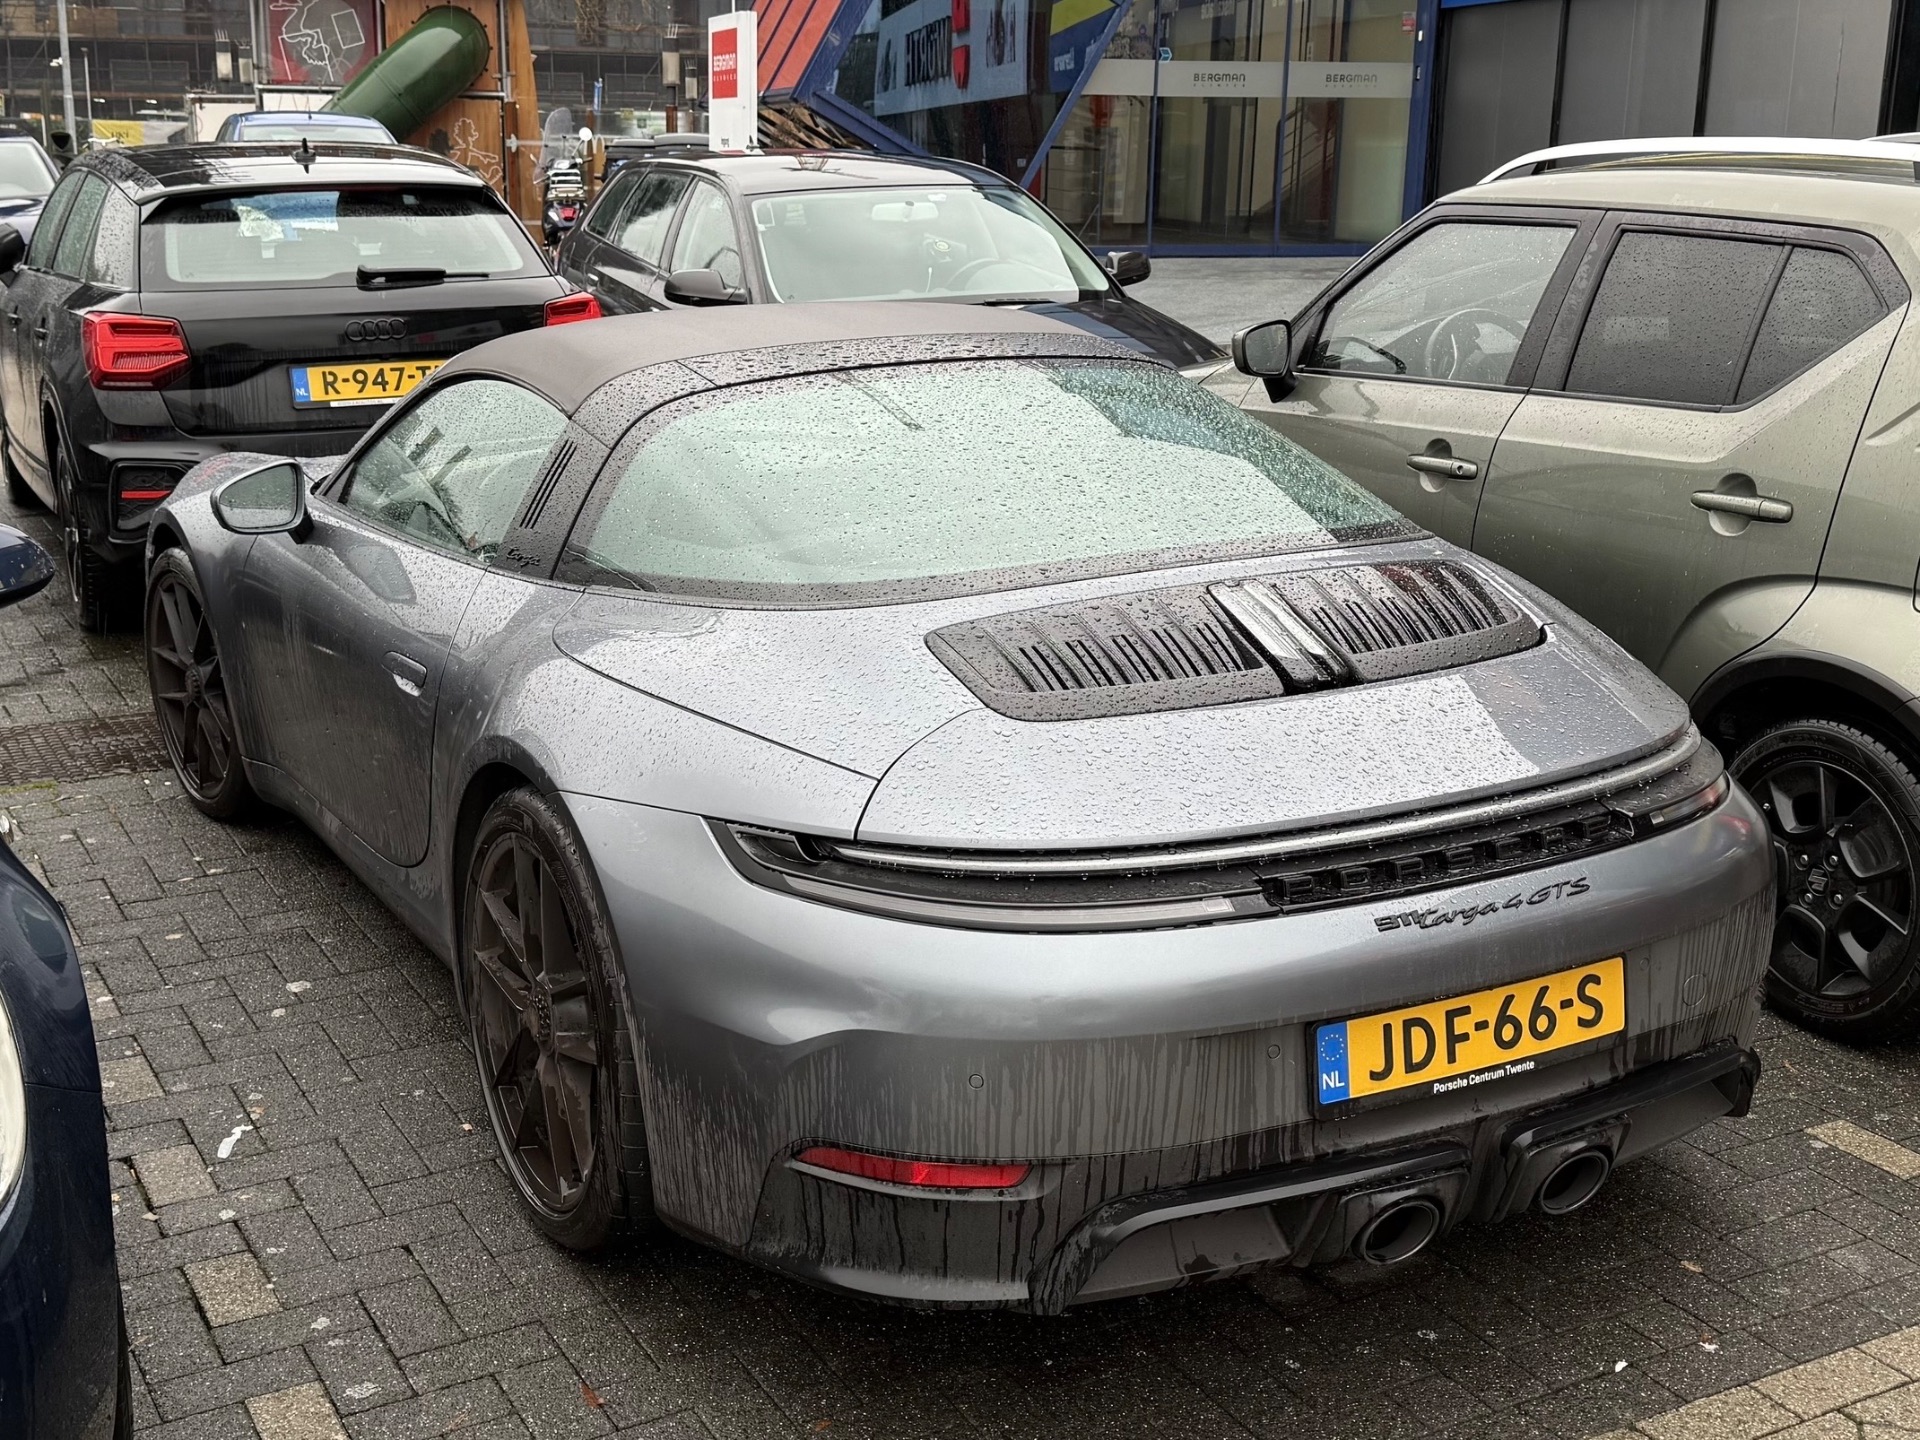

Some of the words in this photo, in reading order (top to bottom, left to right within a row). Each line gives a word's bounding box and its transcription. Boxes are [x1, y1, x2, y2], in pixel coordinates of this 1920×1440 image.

[713, 53, 736, 72] BERGMAN
[1193, 73, 1246, 82] BERGMAN
[1325, 73, 1378, 83] BERGMAN
[295, 387, 308, 396] NL
[321, 364, 439, 396] R-947-T
[1281, 814, 1612, 898] PORSCHE
[1526, 876, 1590, 906] GTS
[1369, 973, 1604, 1081] JDF-66-S
[1322, 1070, 1345, 1090] NL
[1433, 1078, 1468, 1094] Porsche
[1469, 1069, 1505, 1085] Centrum
[1505, 1061, 1535, 1075] Twente
